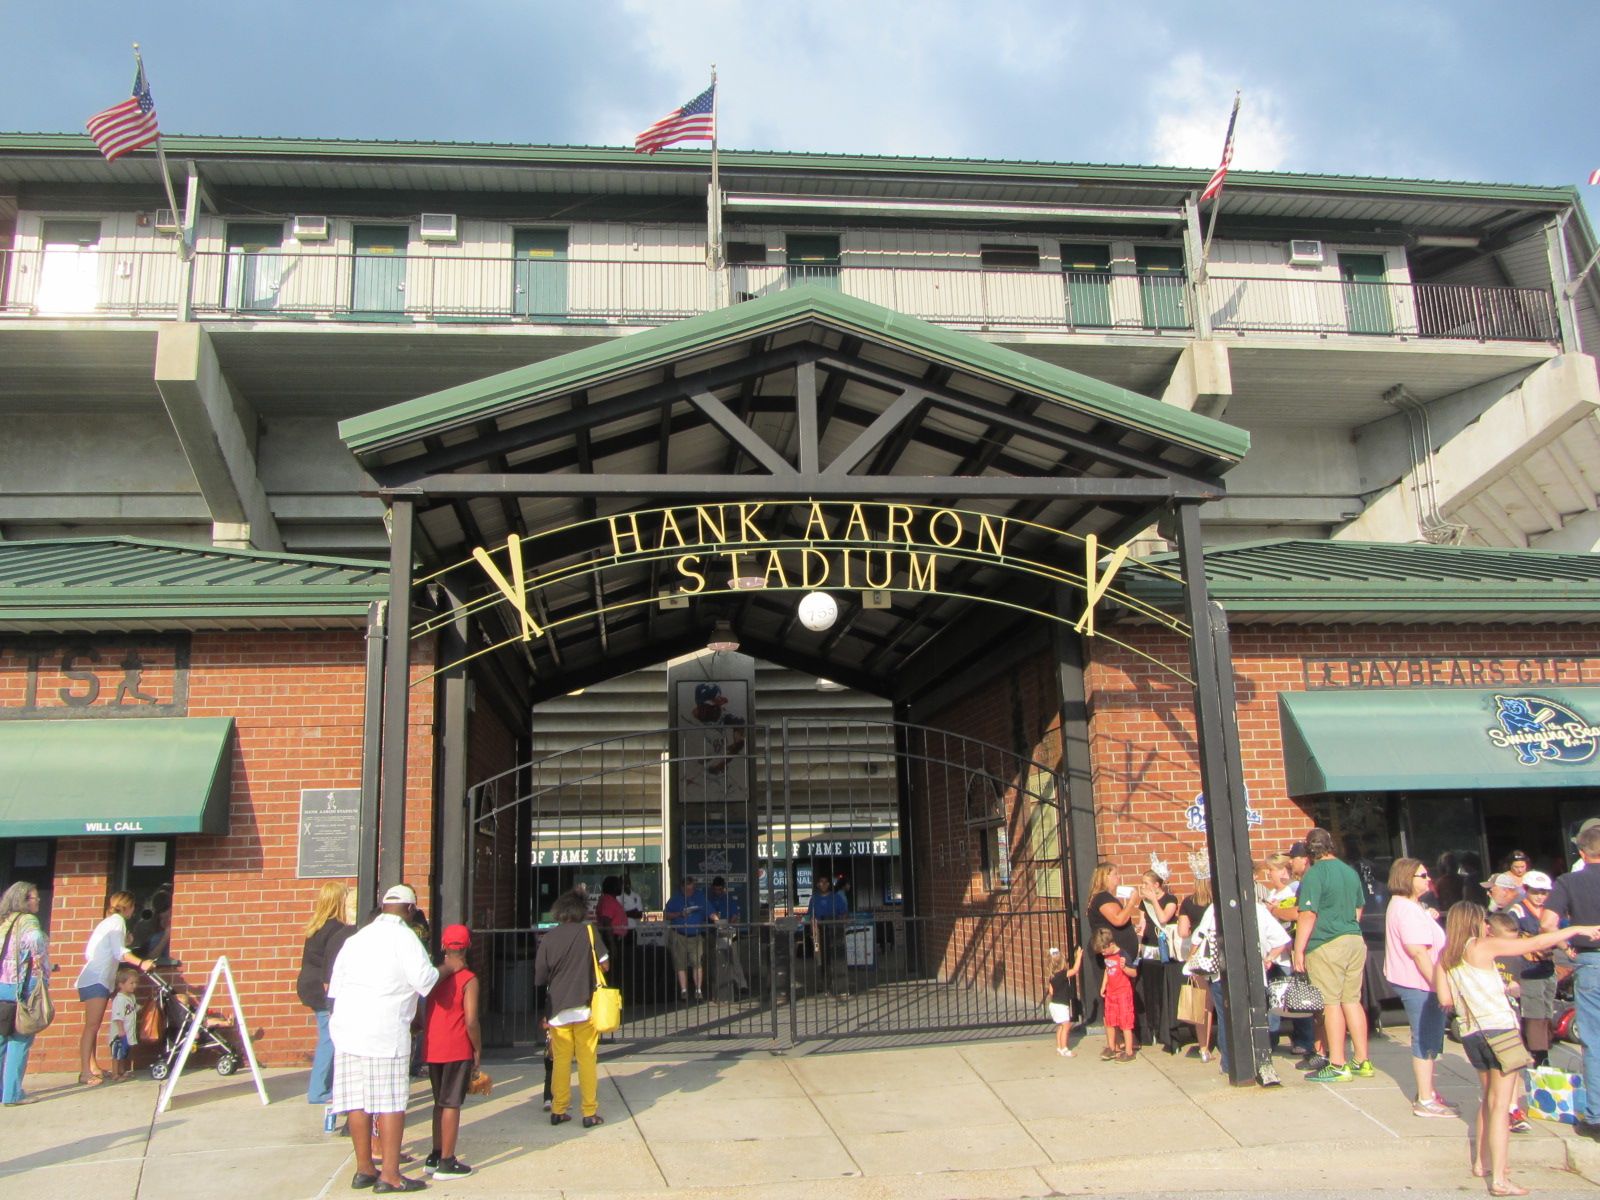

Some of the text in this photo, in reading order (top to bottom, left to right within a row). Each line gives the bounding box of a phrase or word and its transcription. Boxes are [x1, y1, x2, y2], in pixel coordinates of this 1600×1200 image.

[608, 503, 1008, 557] HANK AARON
[677, 549, 937, 594] STADIUM
[1348, 658, 1584, 686] BAYBEARS GIFT
[1488, 728, 1571, 749] Swinging
[86, 822, 143, 832] WILL CALL
[552, 850, 588, 863] FAME
[596, 848, 636, 862] SUITE
[807, 842, 842, 855] FAME
[849, 840, 888, 855] SUITE
